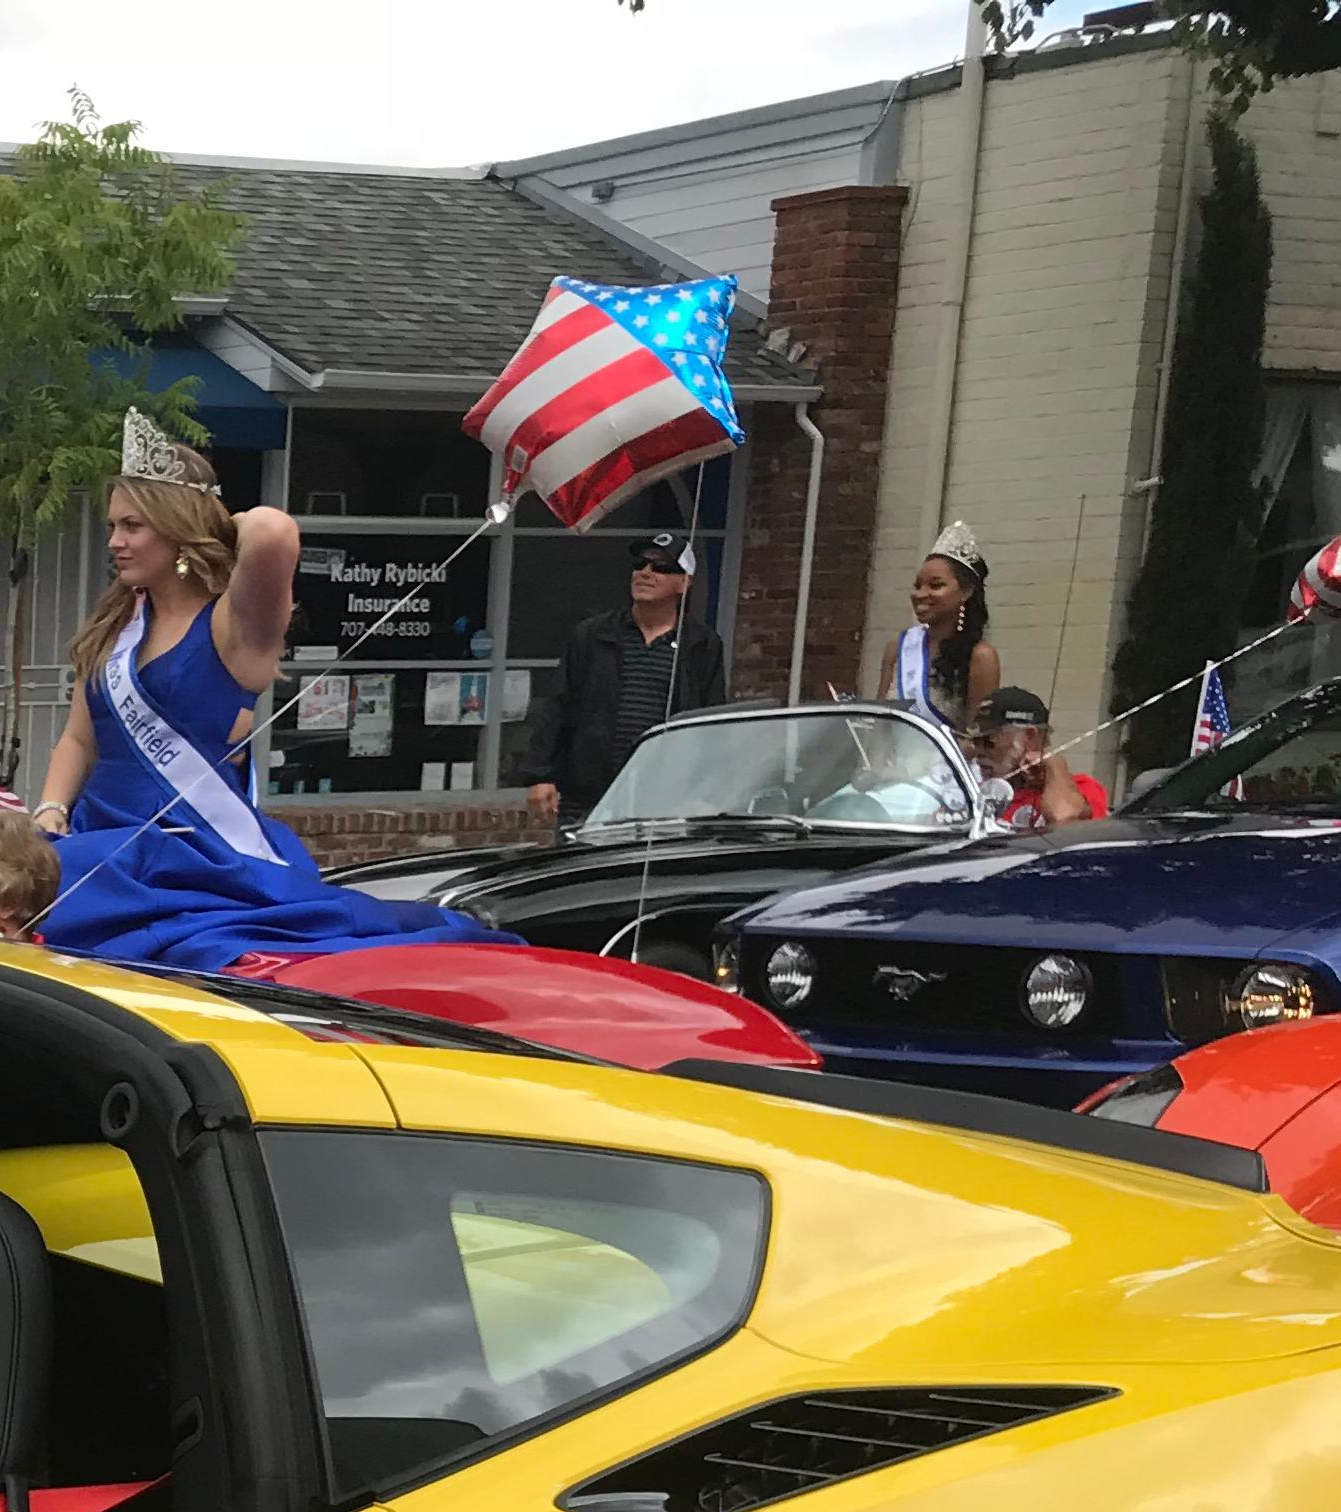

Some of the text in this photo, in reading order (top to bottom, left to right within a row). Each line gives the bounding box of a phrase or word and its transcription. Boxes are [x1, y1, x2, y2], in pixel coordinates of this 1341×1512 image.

[330, 562, 448, 587] Kathy Rybicki
[347, 593, 431, 613] Insurance
[118, 694, 182, 768] Fairfield
